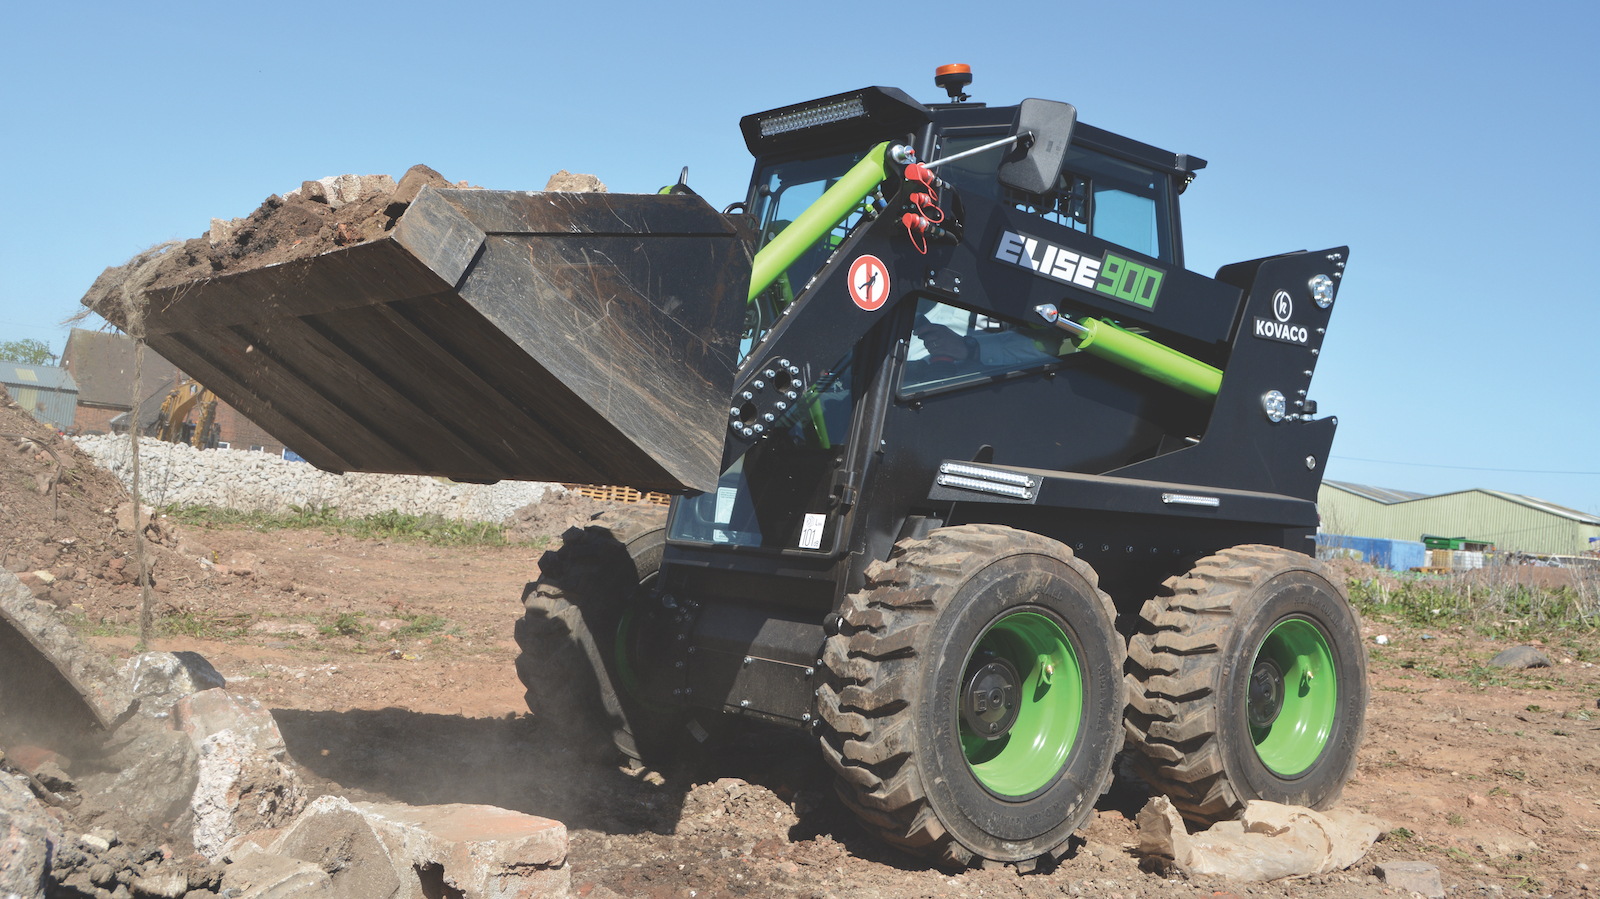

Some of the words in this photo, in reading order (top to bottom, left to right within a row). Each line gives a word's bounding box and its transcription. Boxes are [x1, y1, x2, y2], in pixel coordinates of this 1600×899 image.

[995, 230, 1101, 289] ELISE
[1096, 254, 1164, 308] 900
[1255, 319, 1308, 343] KOVACO
[801, 528, 816, 547] 101
